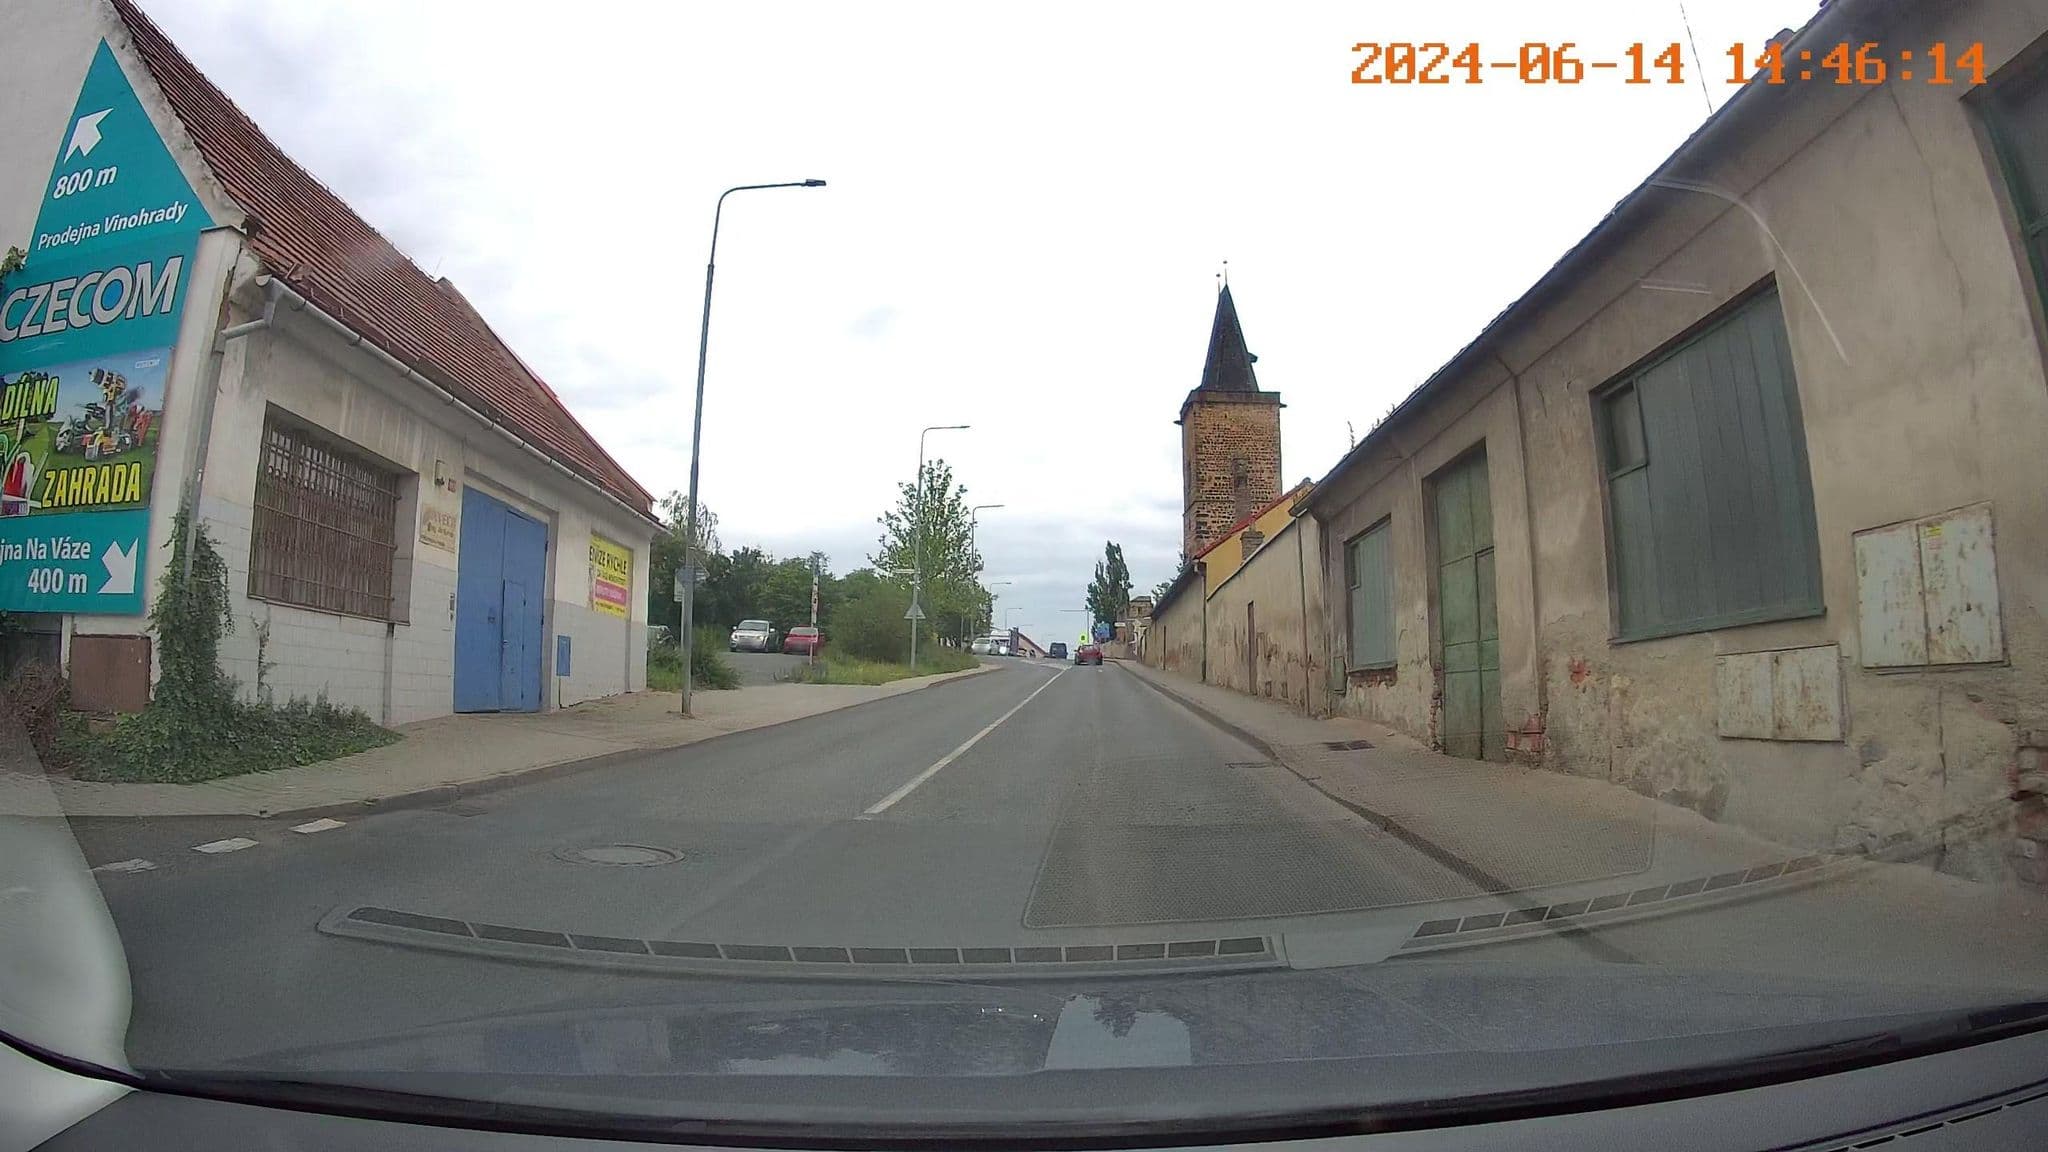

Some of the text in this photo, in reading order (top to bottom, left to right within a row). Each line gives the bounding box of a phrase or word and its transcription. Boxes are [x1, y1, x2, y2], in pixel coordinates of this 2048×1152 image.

[53, 165, 118, 199] 800 m
[38, 201, 188, 251] Prodejna Vinohrady
[0, 255, 184, 342] CZECOM
[2, 374, 59, 421] DÍLNA
[42, 463, 141, 508] ZAHRADA
[26, 538, 48, 560] Na
[51, 537, 91, 560] Váze
[28, 568, 87, 594] 400 m
